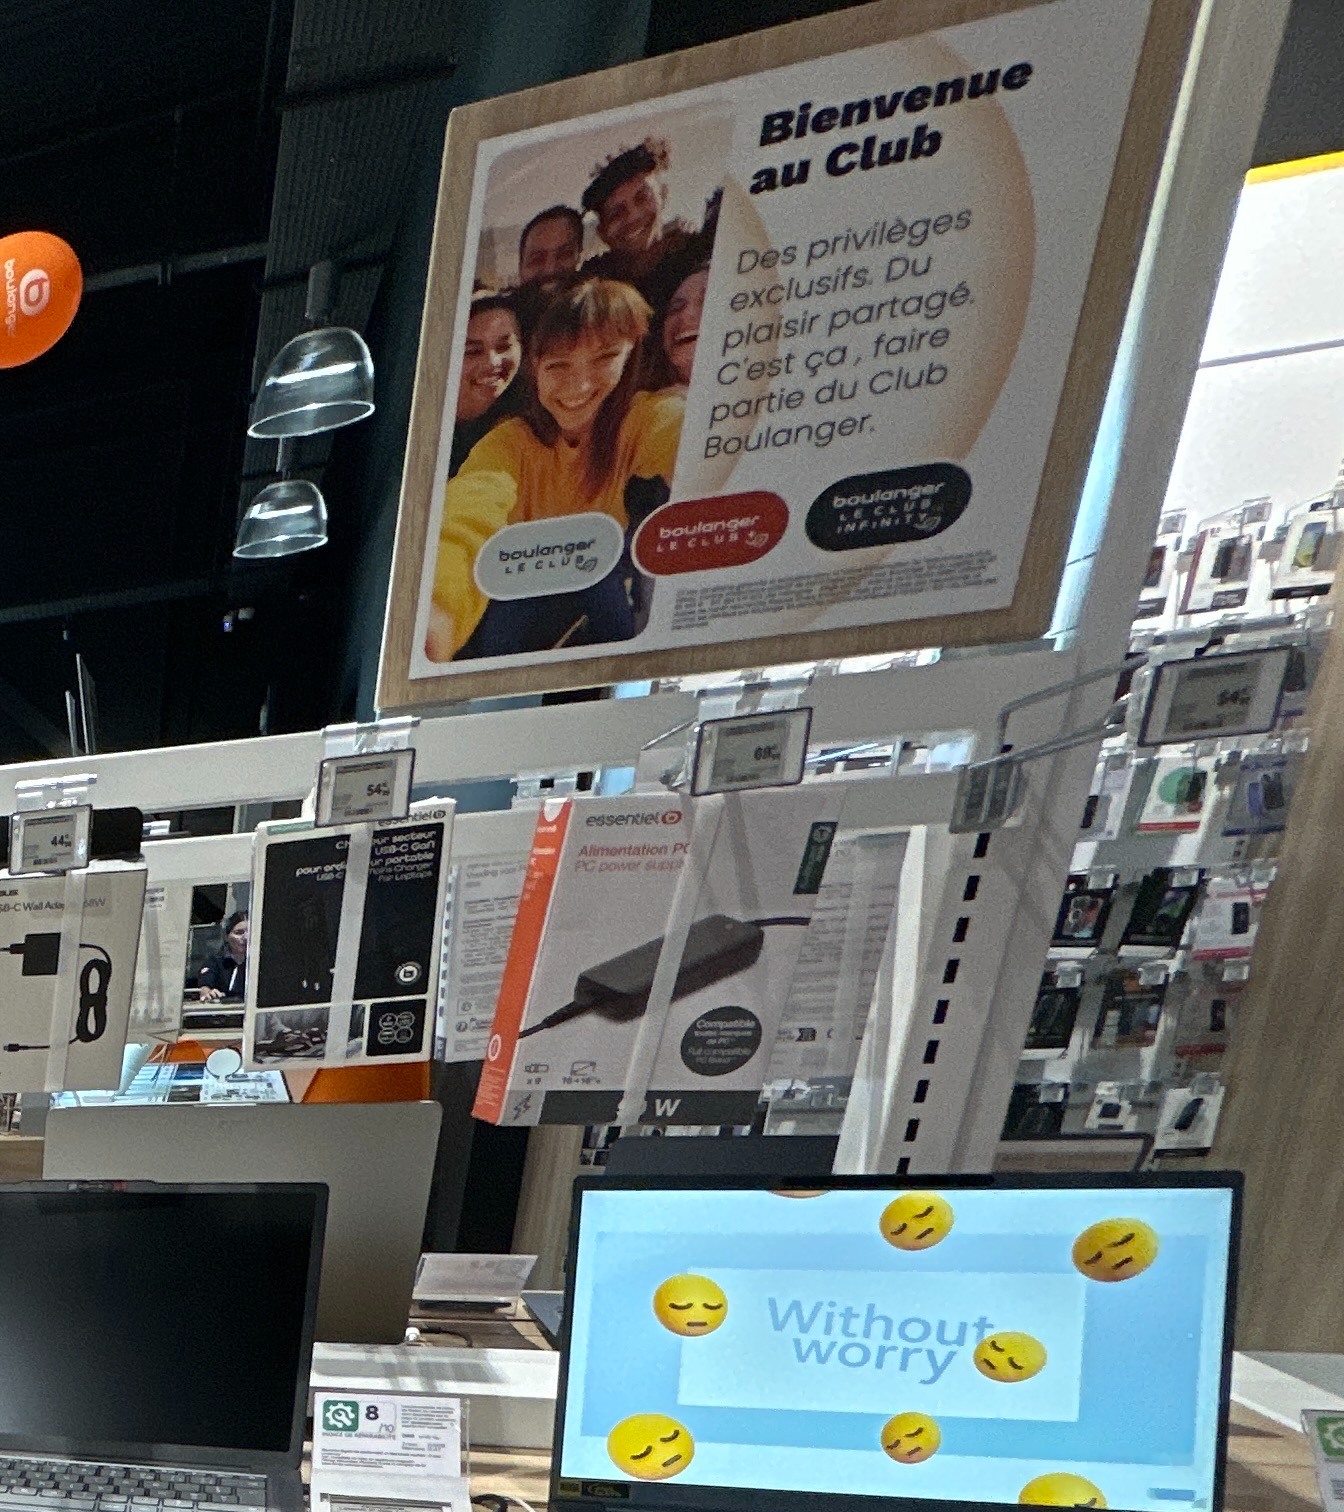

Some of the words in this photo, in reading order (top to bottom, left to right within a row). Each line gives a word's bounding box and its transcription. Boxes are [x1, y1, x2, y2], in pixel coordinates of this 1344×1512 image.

[760, 62, 1033, 146] Bienvenue
[750, 160, 811, 194] au
[826, 123, 942, 167] Club
[737, 246, 797, 274] Des
[805, 209, 972, 267] privilèges
[730, 265, 872, 311] exclusifs.
[885, 255, 932, 283] Du
[722, 310, 820, 357] plaisir
[828, 281, 975, 336] partagé.
[717, 352, 795, 385] C'est
[874, 328, 950, 357] faire
[709, 389, 805, 425] partie
[815, 380, 858, 404] du
[869, 363, 948, 393] Club
[703, 413, 875, 459] Boulanger.
[832, 482, 945, 508] boulanger
[499, 538, 596, 561] boulanger
[660, 516, 760, 538] boulanger
[689, 534, 739, 549] CLUB
[505, 562, 525, 574] LE
[585, 811, 660, 827] essentiel
[578, 843, 669, 857] Alimentation
[768, 1297, 995, 1347] Without
[792, 1338, 958, 1385] worry
[365, 1405, 379, 1421] 8
